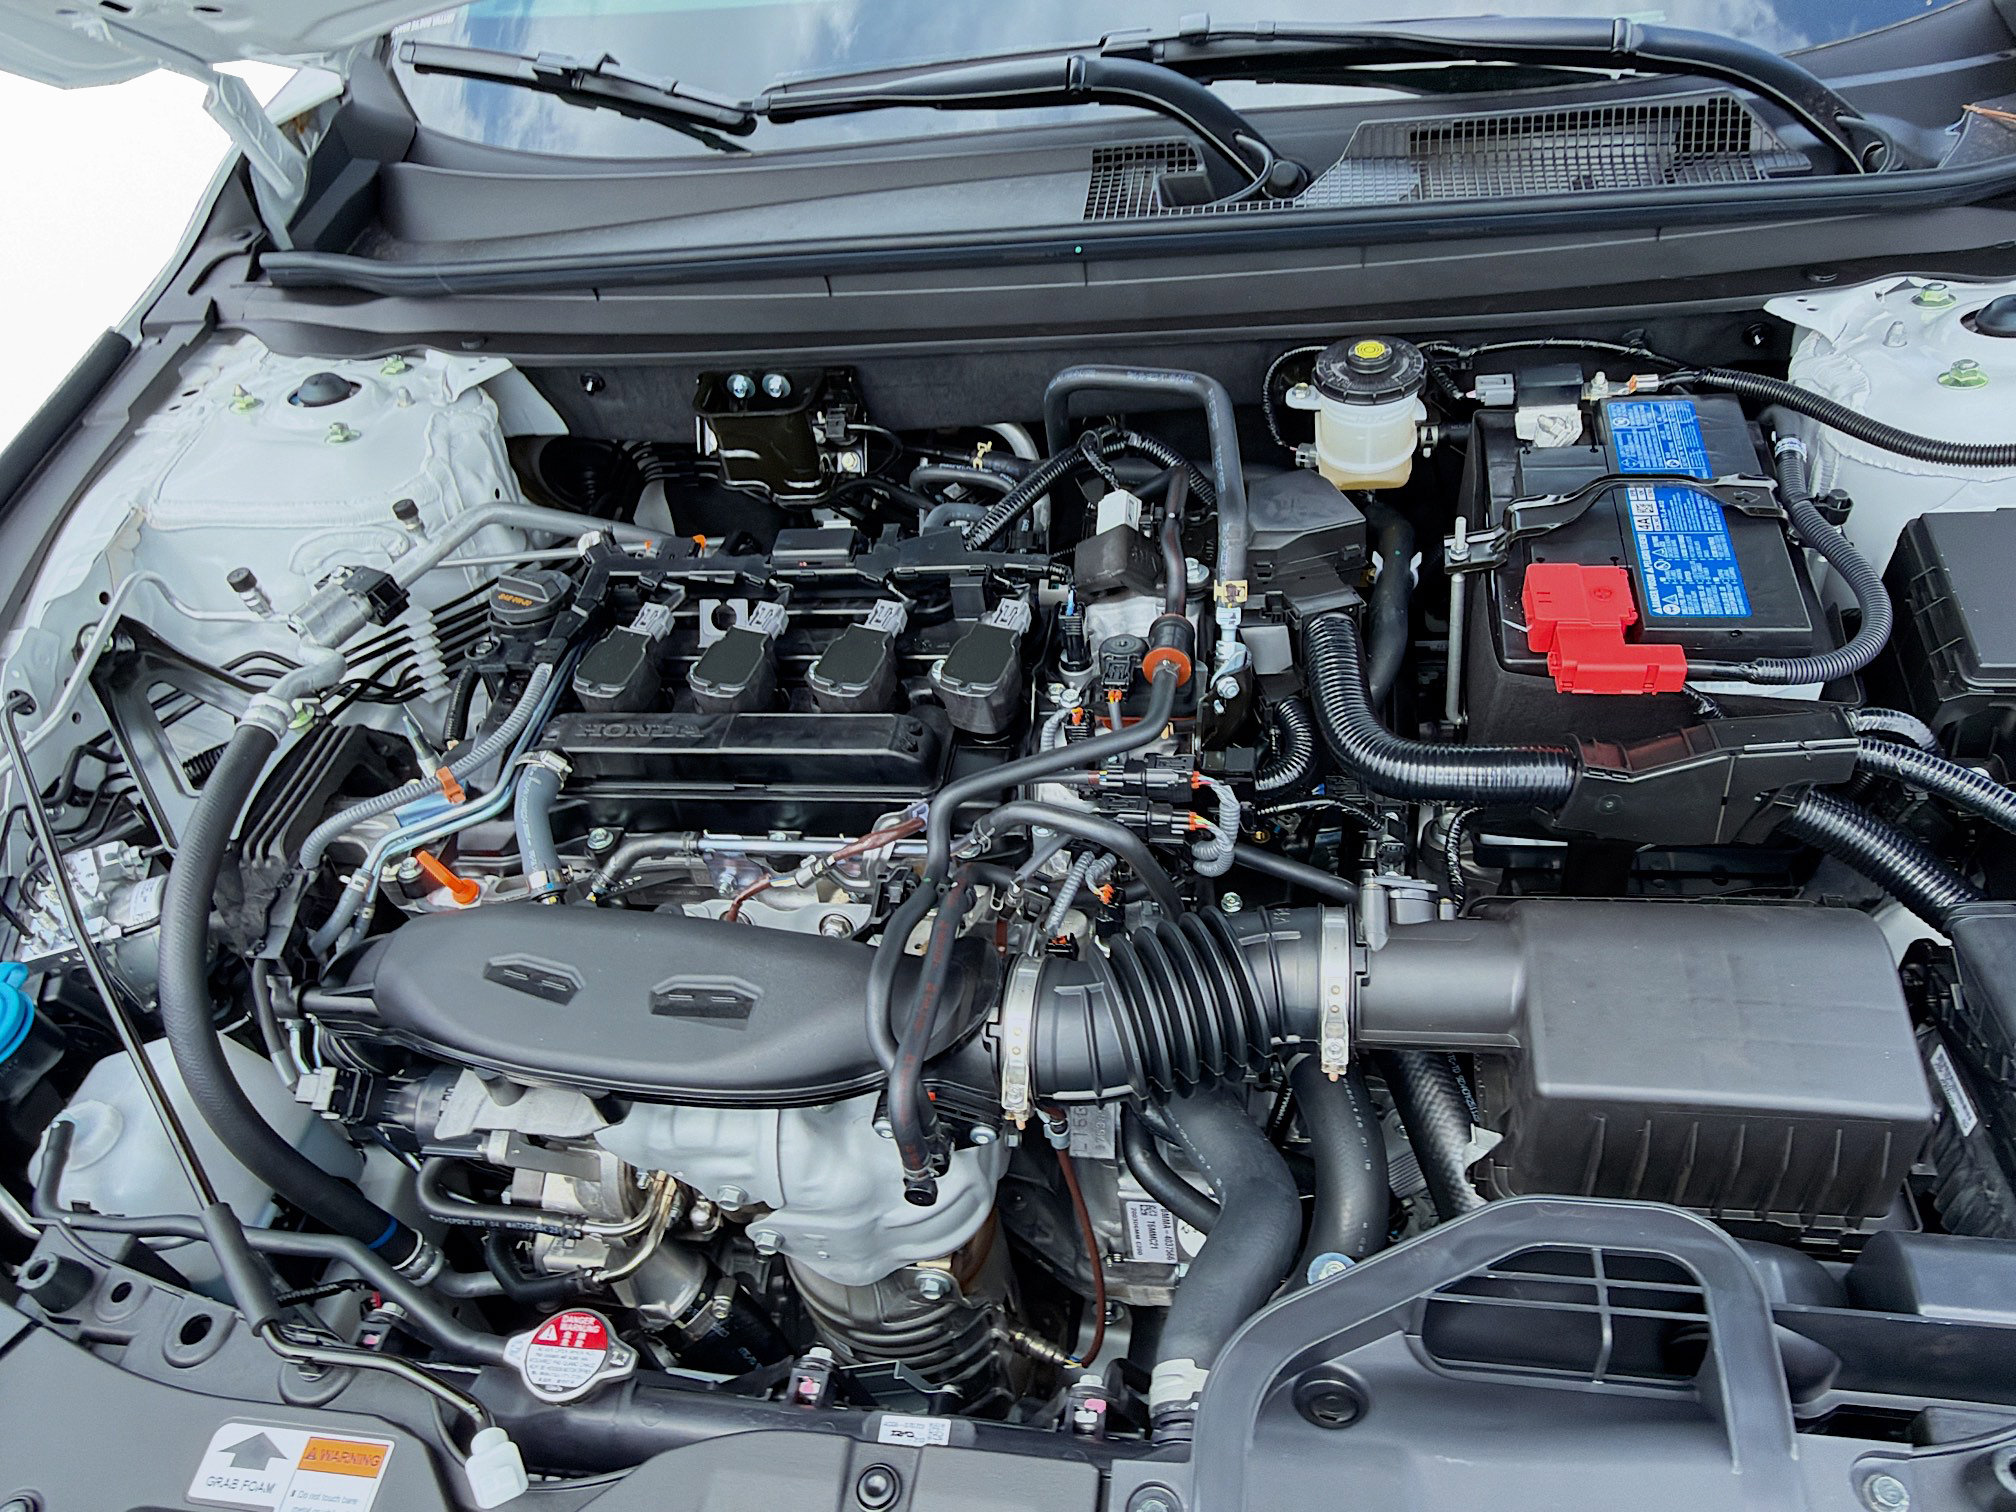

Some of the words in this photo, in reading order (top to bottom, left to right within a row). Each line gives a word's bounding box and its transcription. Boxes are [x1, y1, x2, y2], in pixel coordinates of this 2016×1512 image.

[575, 723, 704, 738] HONDA
[320, 1448, 383, 1467] WARNING
[206, 1475, 238, 1490] GRAB
[241, 1480, 277, 1494] FOAM
